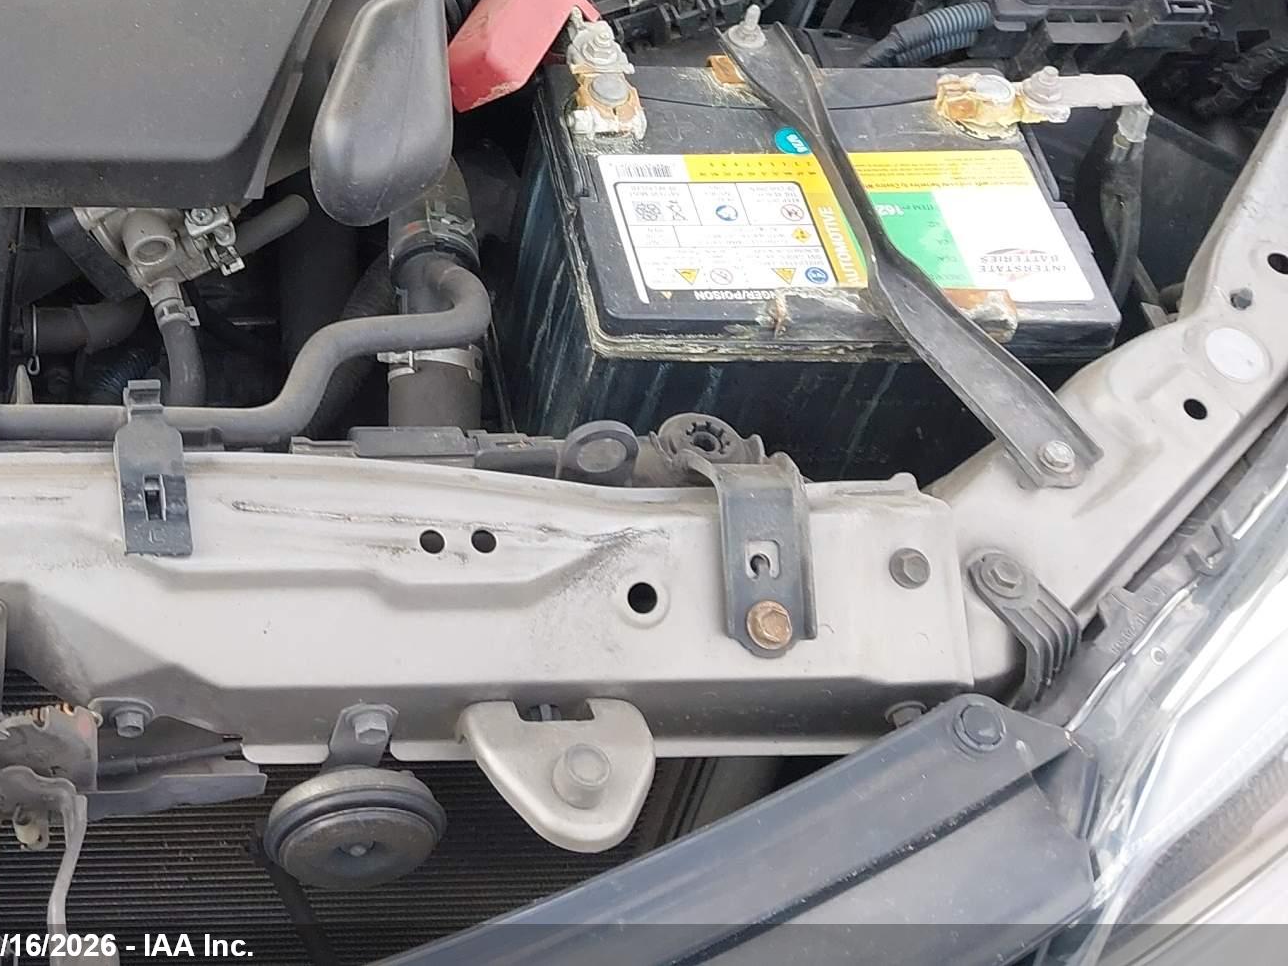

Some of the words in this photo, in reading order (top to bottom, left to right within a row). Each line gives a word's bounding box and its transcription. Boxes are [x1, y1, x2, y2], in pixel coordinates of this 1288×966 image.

[817, 204, 861, 284] AUTOMOTIVE
[979, 255, 1059, 264] BATTERIES
[977, 265, 1066, 273] INTERSTATE
[694, 289, 777, 301] NGER/POISON
